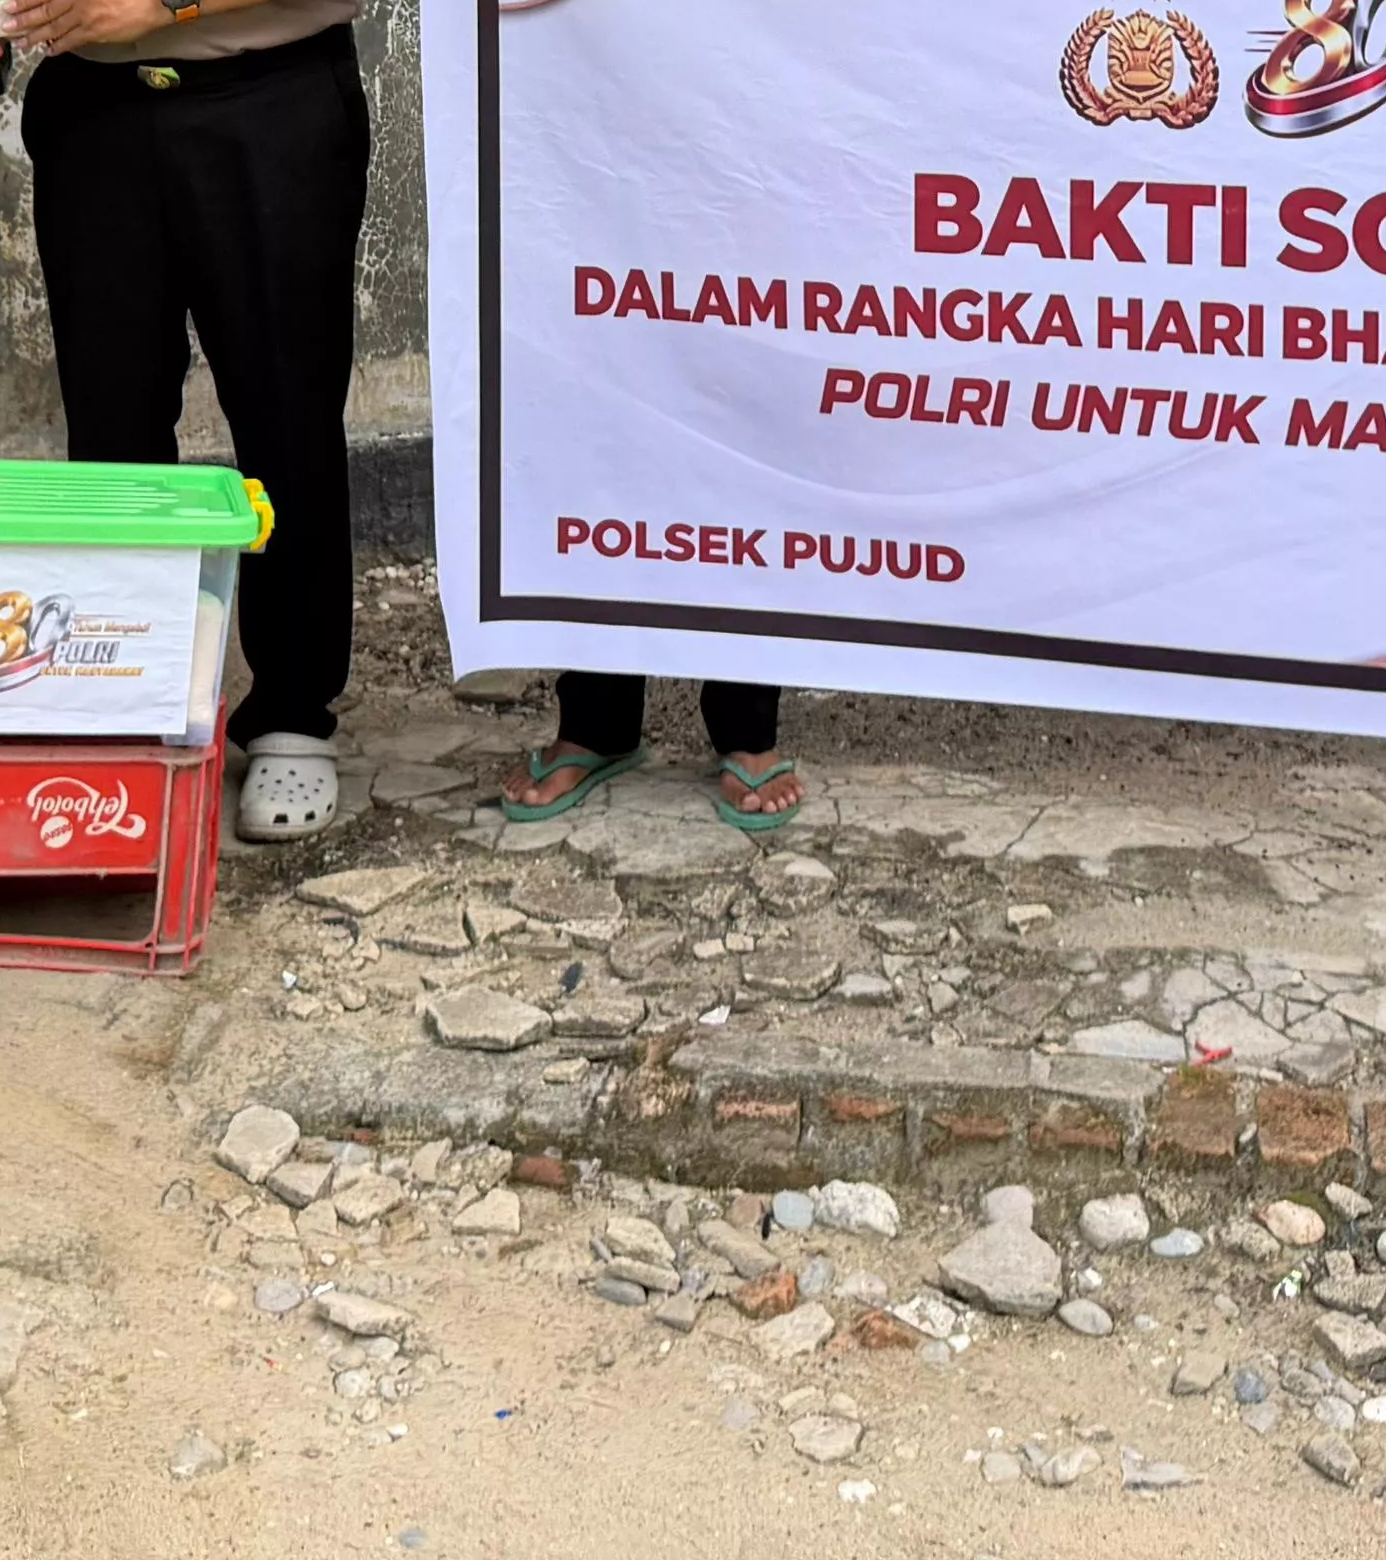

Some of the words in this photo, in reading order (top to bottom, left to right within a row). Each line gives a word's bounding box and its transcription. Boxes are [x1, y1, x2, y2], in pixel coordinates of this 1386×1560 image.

[914, 172, 1249, 268] BAKTI
[573, 265, 789, 330] DALAM
[802, 280, 1084, 348] RANGKA
[1096, 296, 1265, 360] HARI
[819, 367, 1012, 428] POLRI
[1029, 382, 1268, 446] UNTUK
[555, 515, 768, 569] POLSEK
[782, 530, 966, 583] PUJUD
[54, 639, 121, 665] POLRI
[26, 776, 147, 839] Tehbotol
